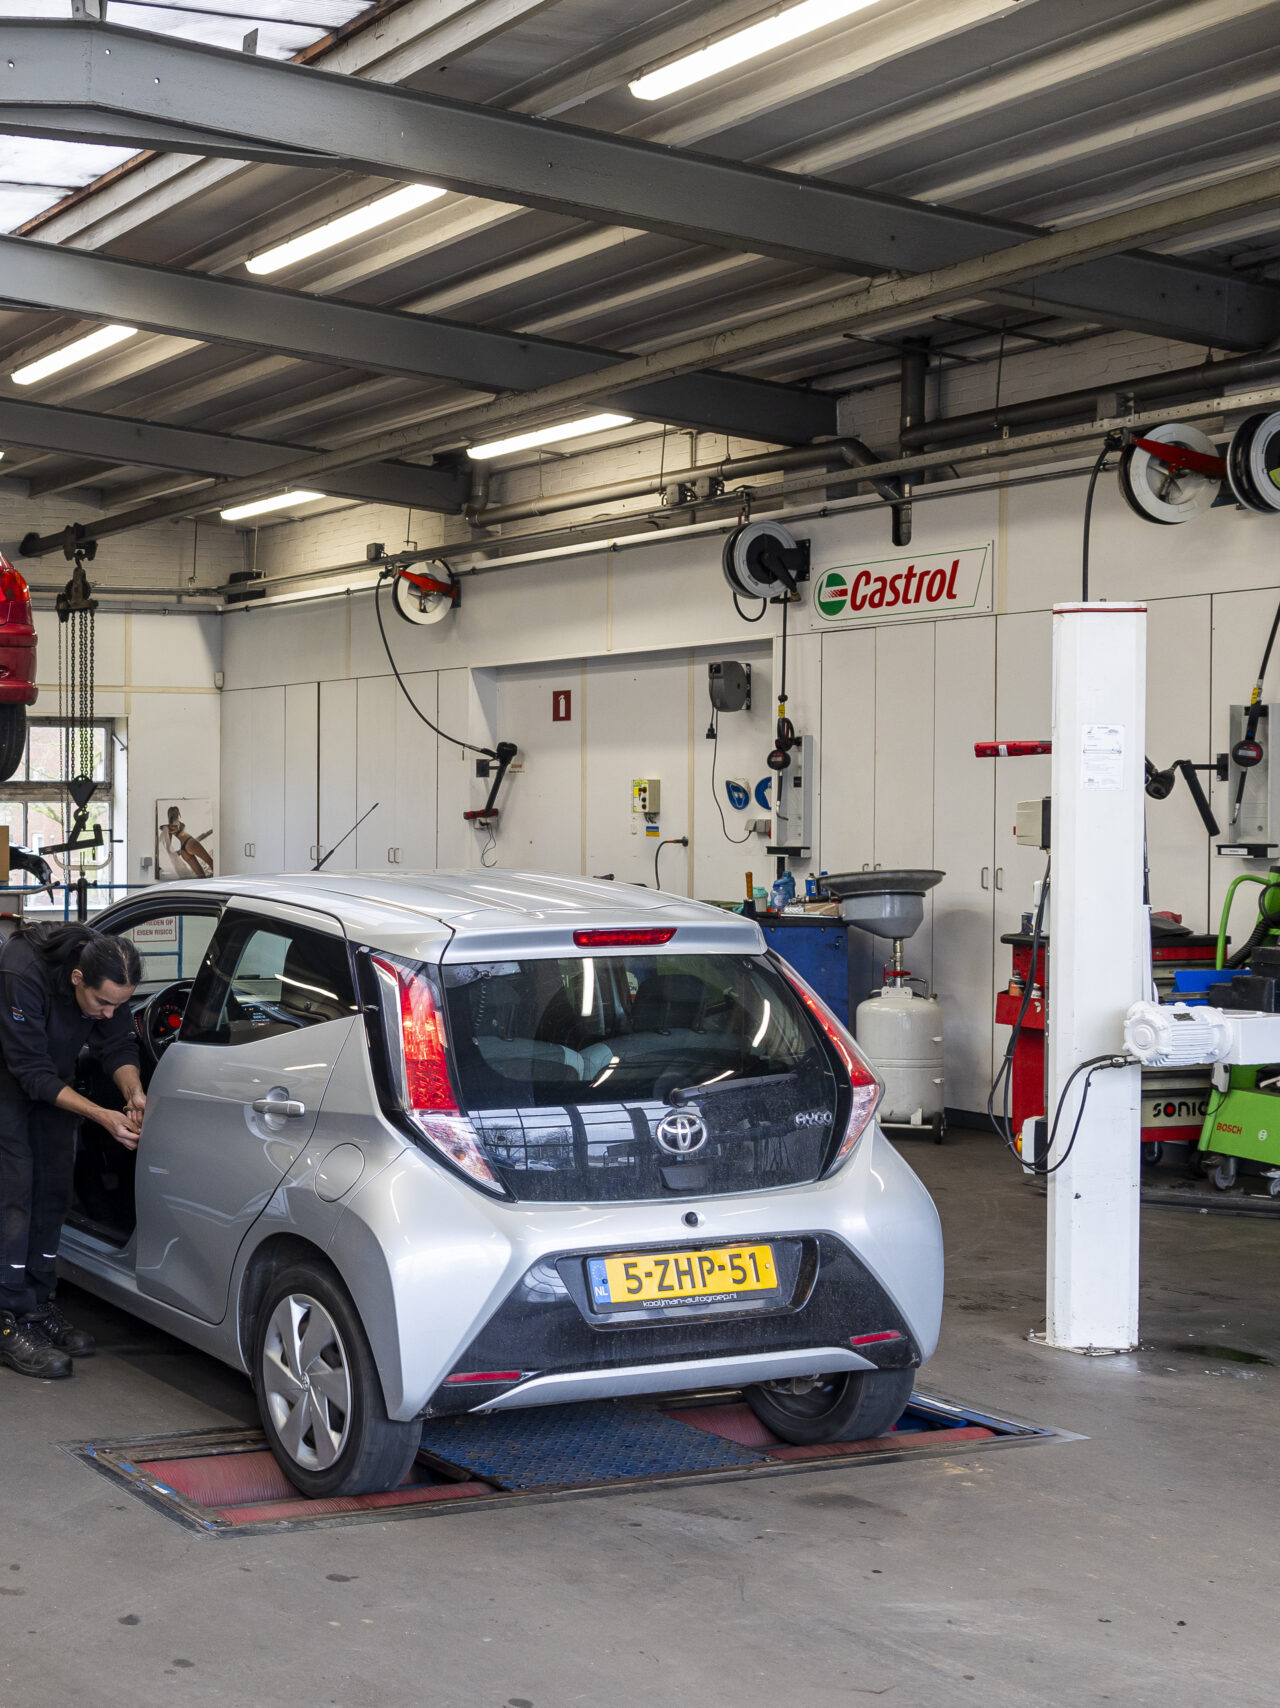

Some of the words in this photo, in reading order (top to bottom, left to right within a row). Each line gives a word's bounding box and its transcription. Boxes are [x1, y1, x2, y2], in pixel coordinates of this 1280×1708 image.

[850, 559, 960, 612] Castrol
[165, 918, 174, 926] OP
[154, 928, 173, 936] RISICO
[795, 1110, 832, 1126] AYGO
[1216, 1122, 1243, 1135] BOSCH
[623, 1252, 761, 1295] 5-ZHP-51
[594, 1285, 609, 1297] NL
[642, 1291, 738, 1308] kooijman-autogroep.nl
